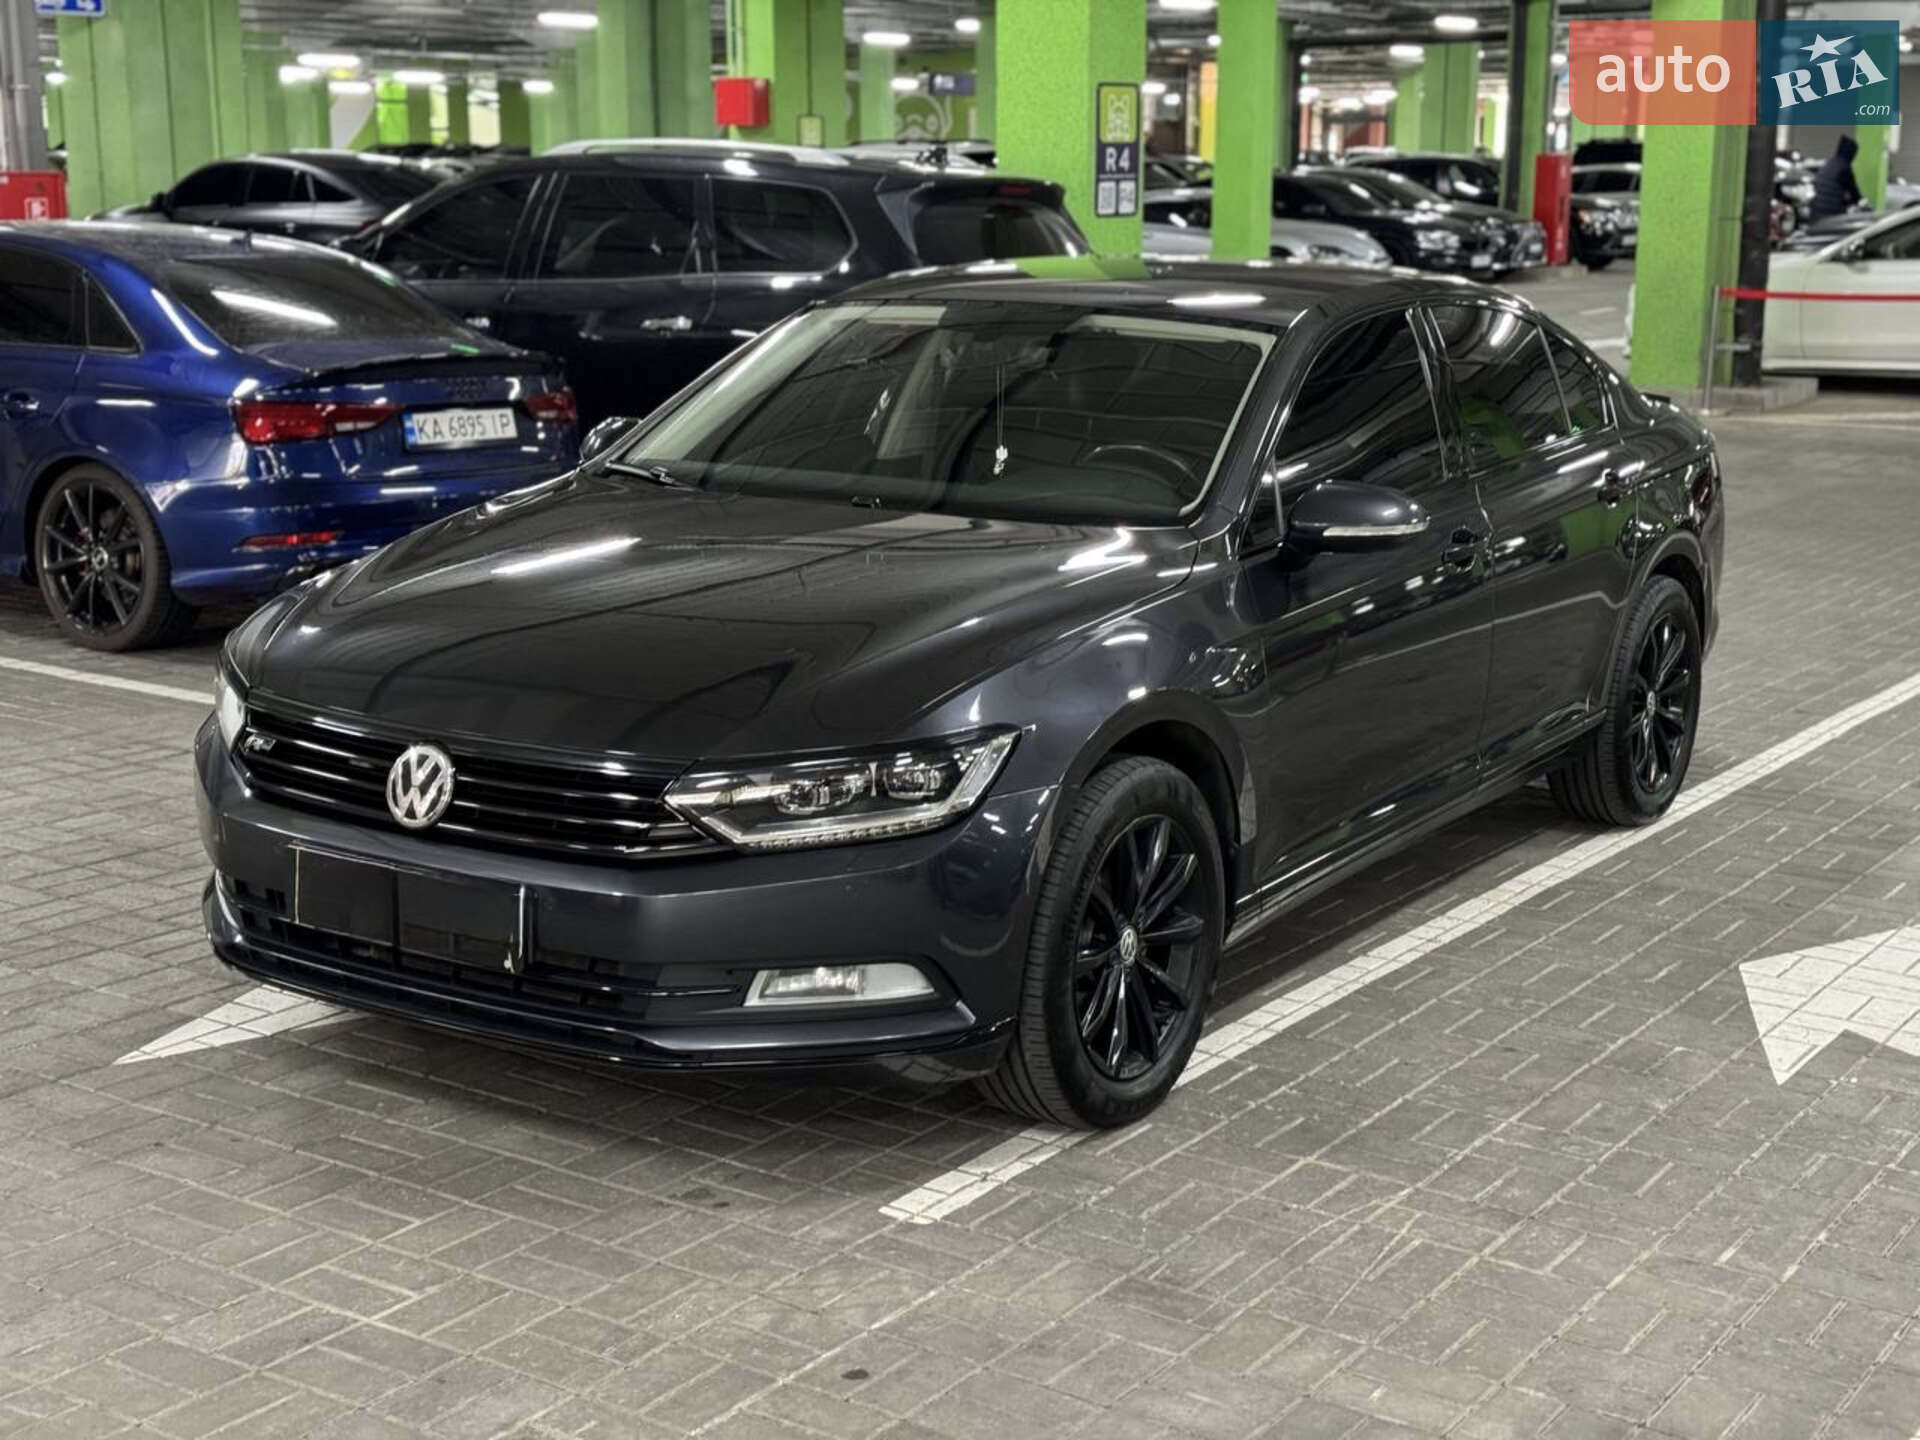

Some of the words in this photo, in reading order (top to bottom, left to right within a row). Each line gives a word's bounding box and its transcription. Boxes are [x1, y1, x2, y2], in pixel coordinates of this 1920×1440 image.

[1105, 146, 1130, 172] R4
[416, 417, 445, 441] KA
[448, 415, 486, 438] 6895
[490, 413, 511, 435] IP
[386, 743, 455, 829] VW
